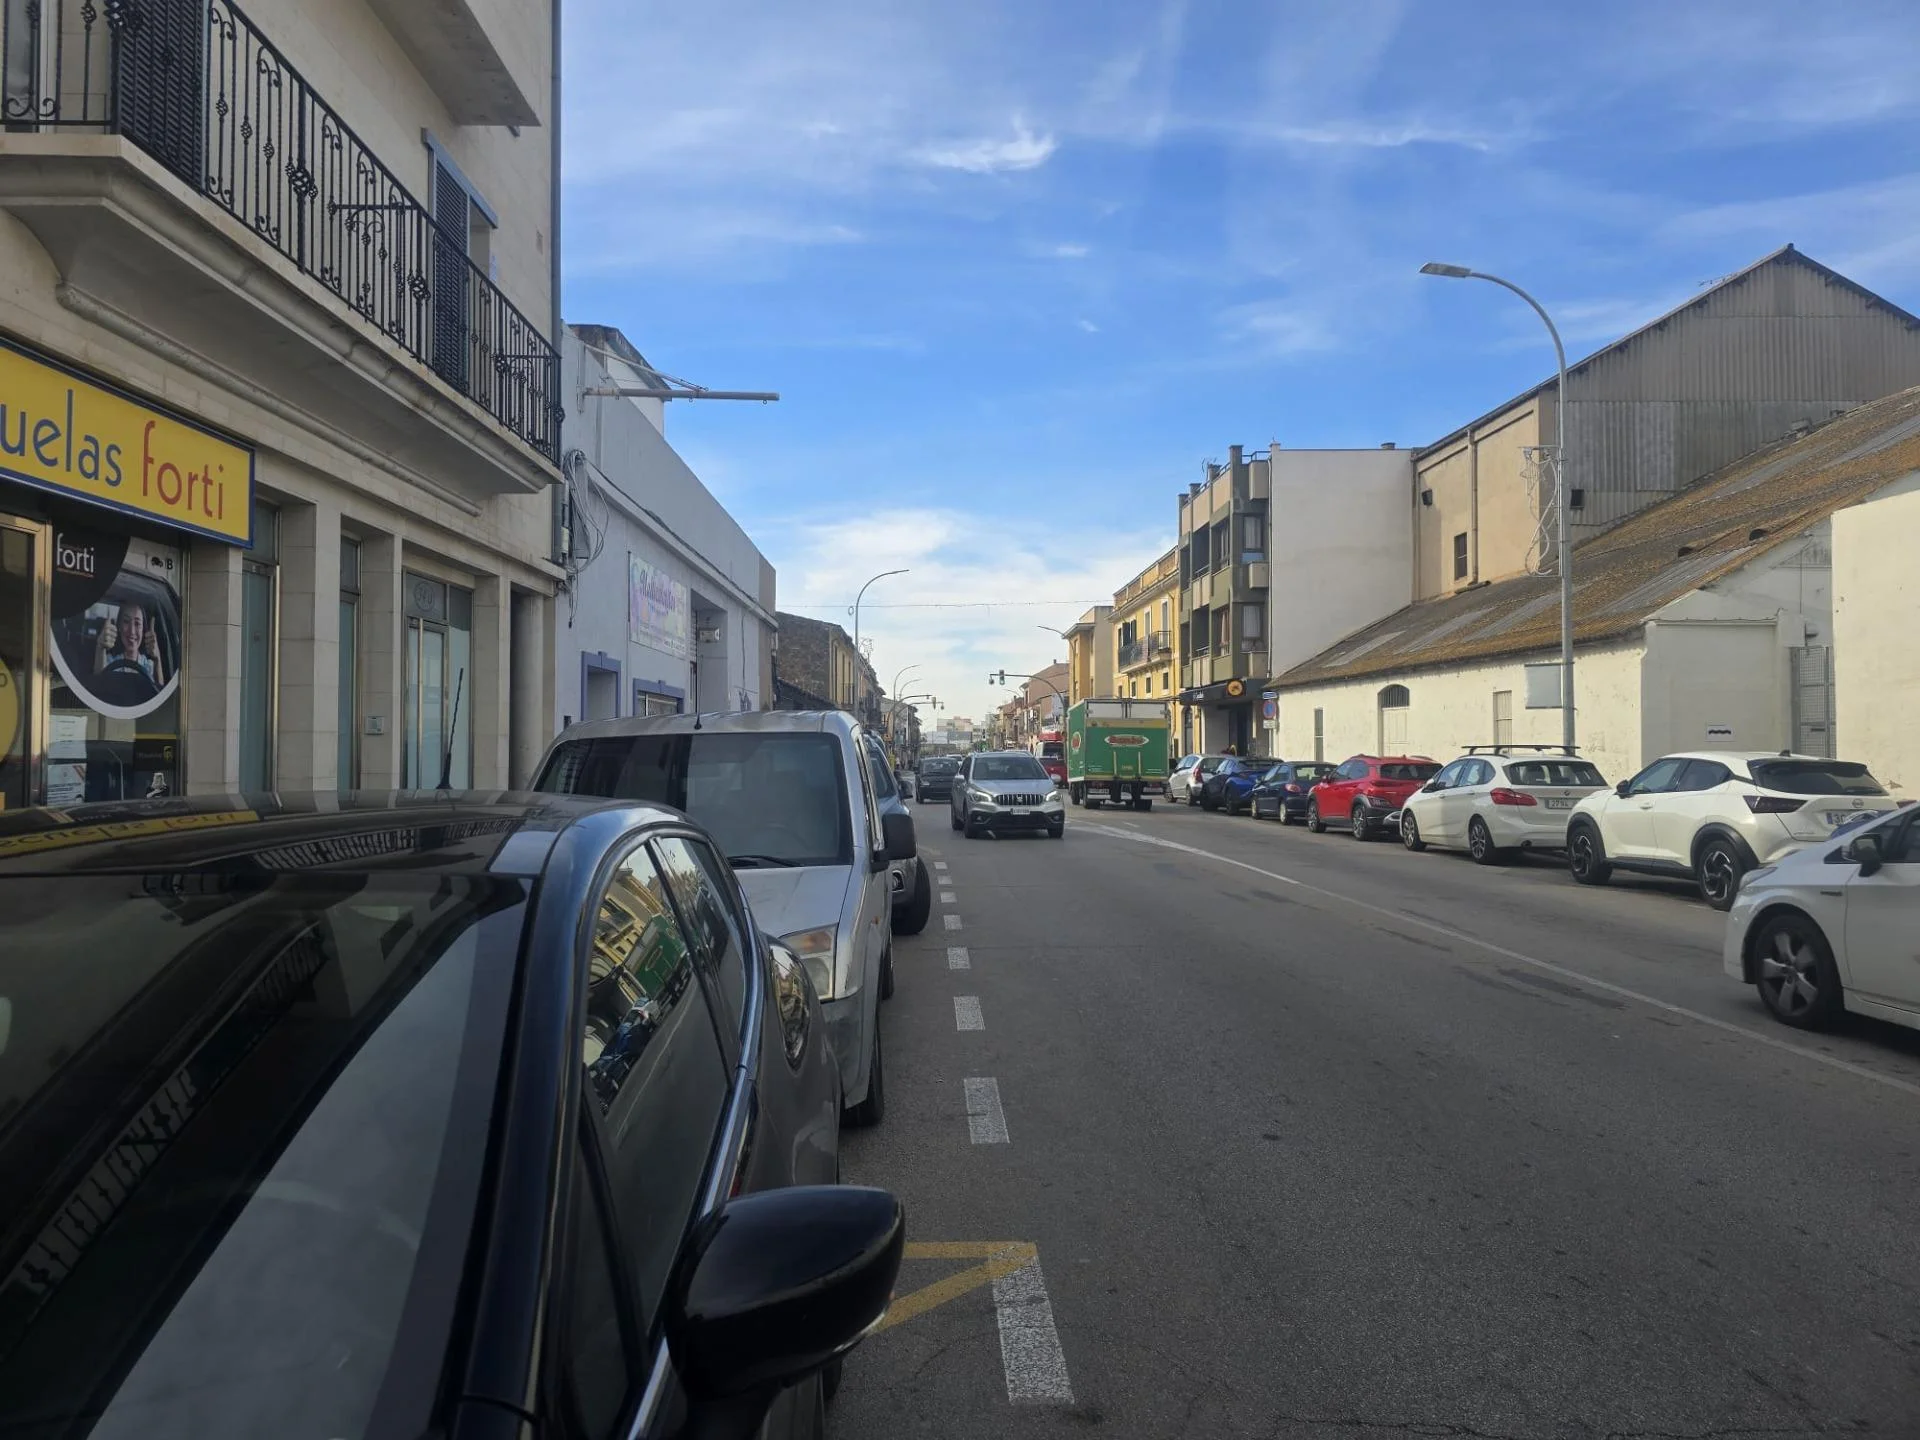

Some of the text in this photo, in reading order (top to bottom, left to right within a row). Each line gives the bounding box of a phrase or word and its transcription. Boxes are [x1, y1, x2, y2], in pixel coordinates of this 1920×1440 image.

[0, 388, 225, 520] uelas forti
[56, 532, 95, 573] forti
